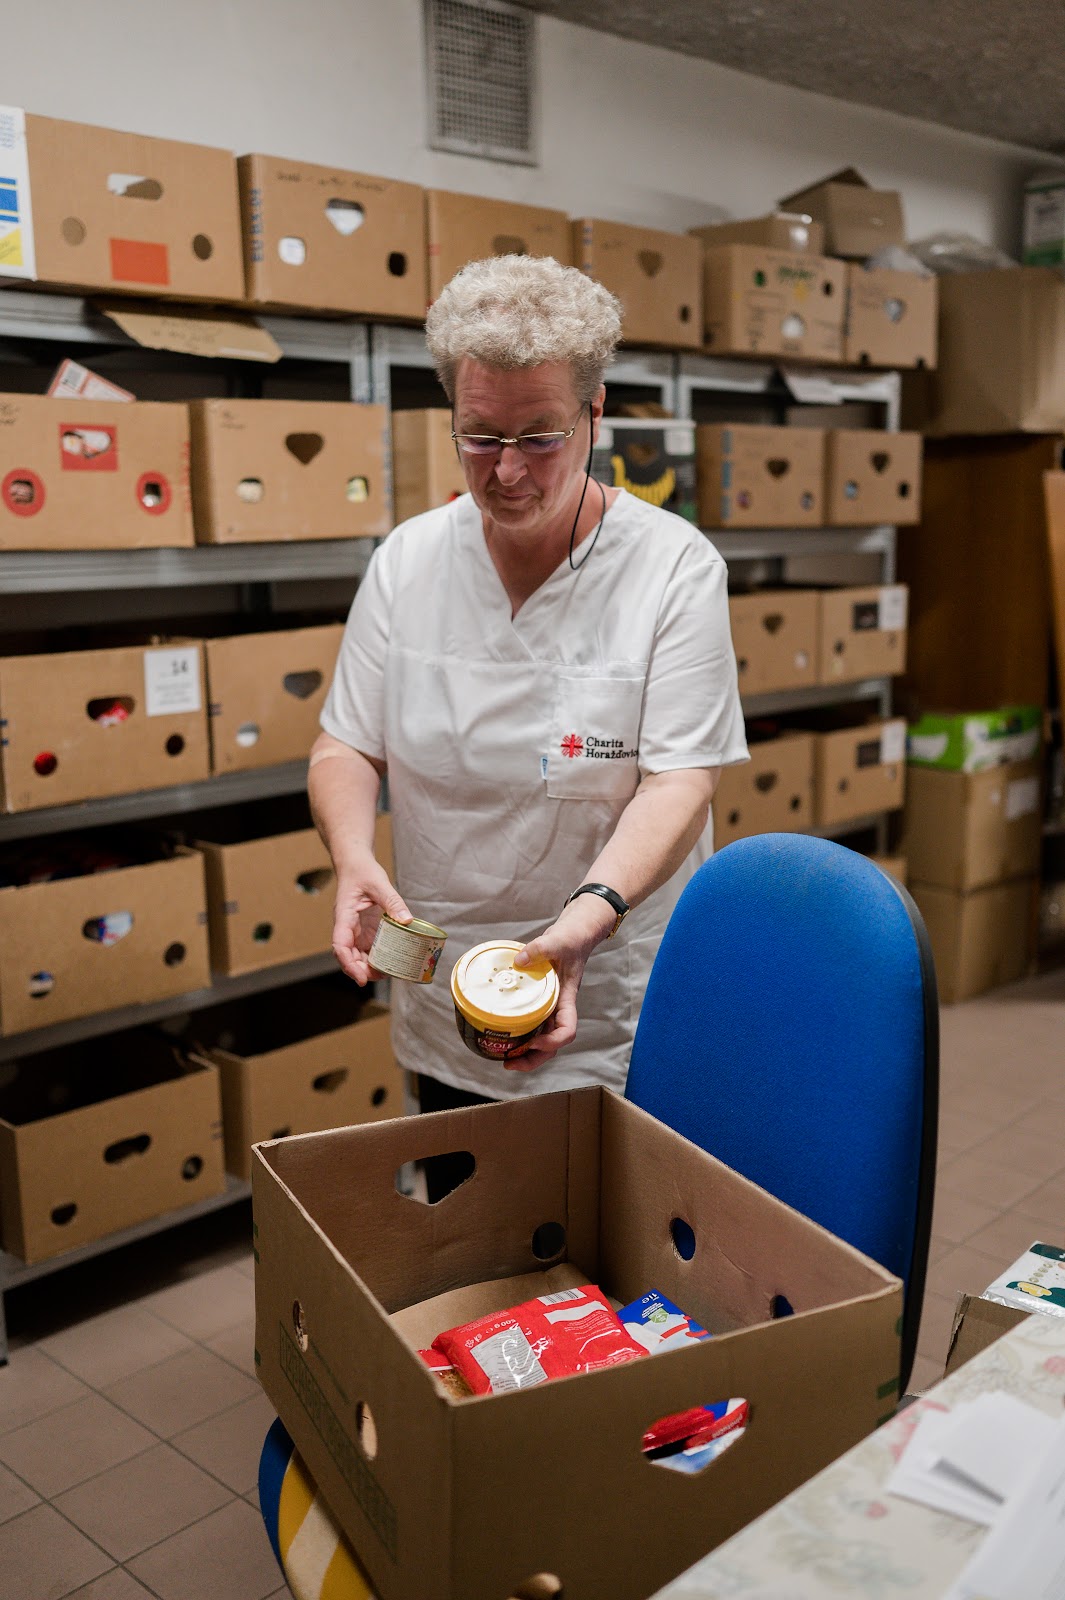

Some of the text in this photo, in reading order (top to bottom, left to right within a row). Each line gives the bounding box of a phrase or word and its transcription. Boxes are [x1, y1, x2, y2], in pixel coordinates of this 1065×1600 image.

[586, 736, 624, 748] Charita
[477, 1037, 513, 1049] FAZOLE
[501, 1318, 517, 1328] 500
